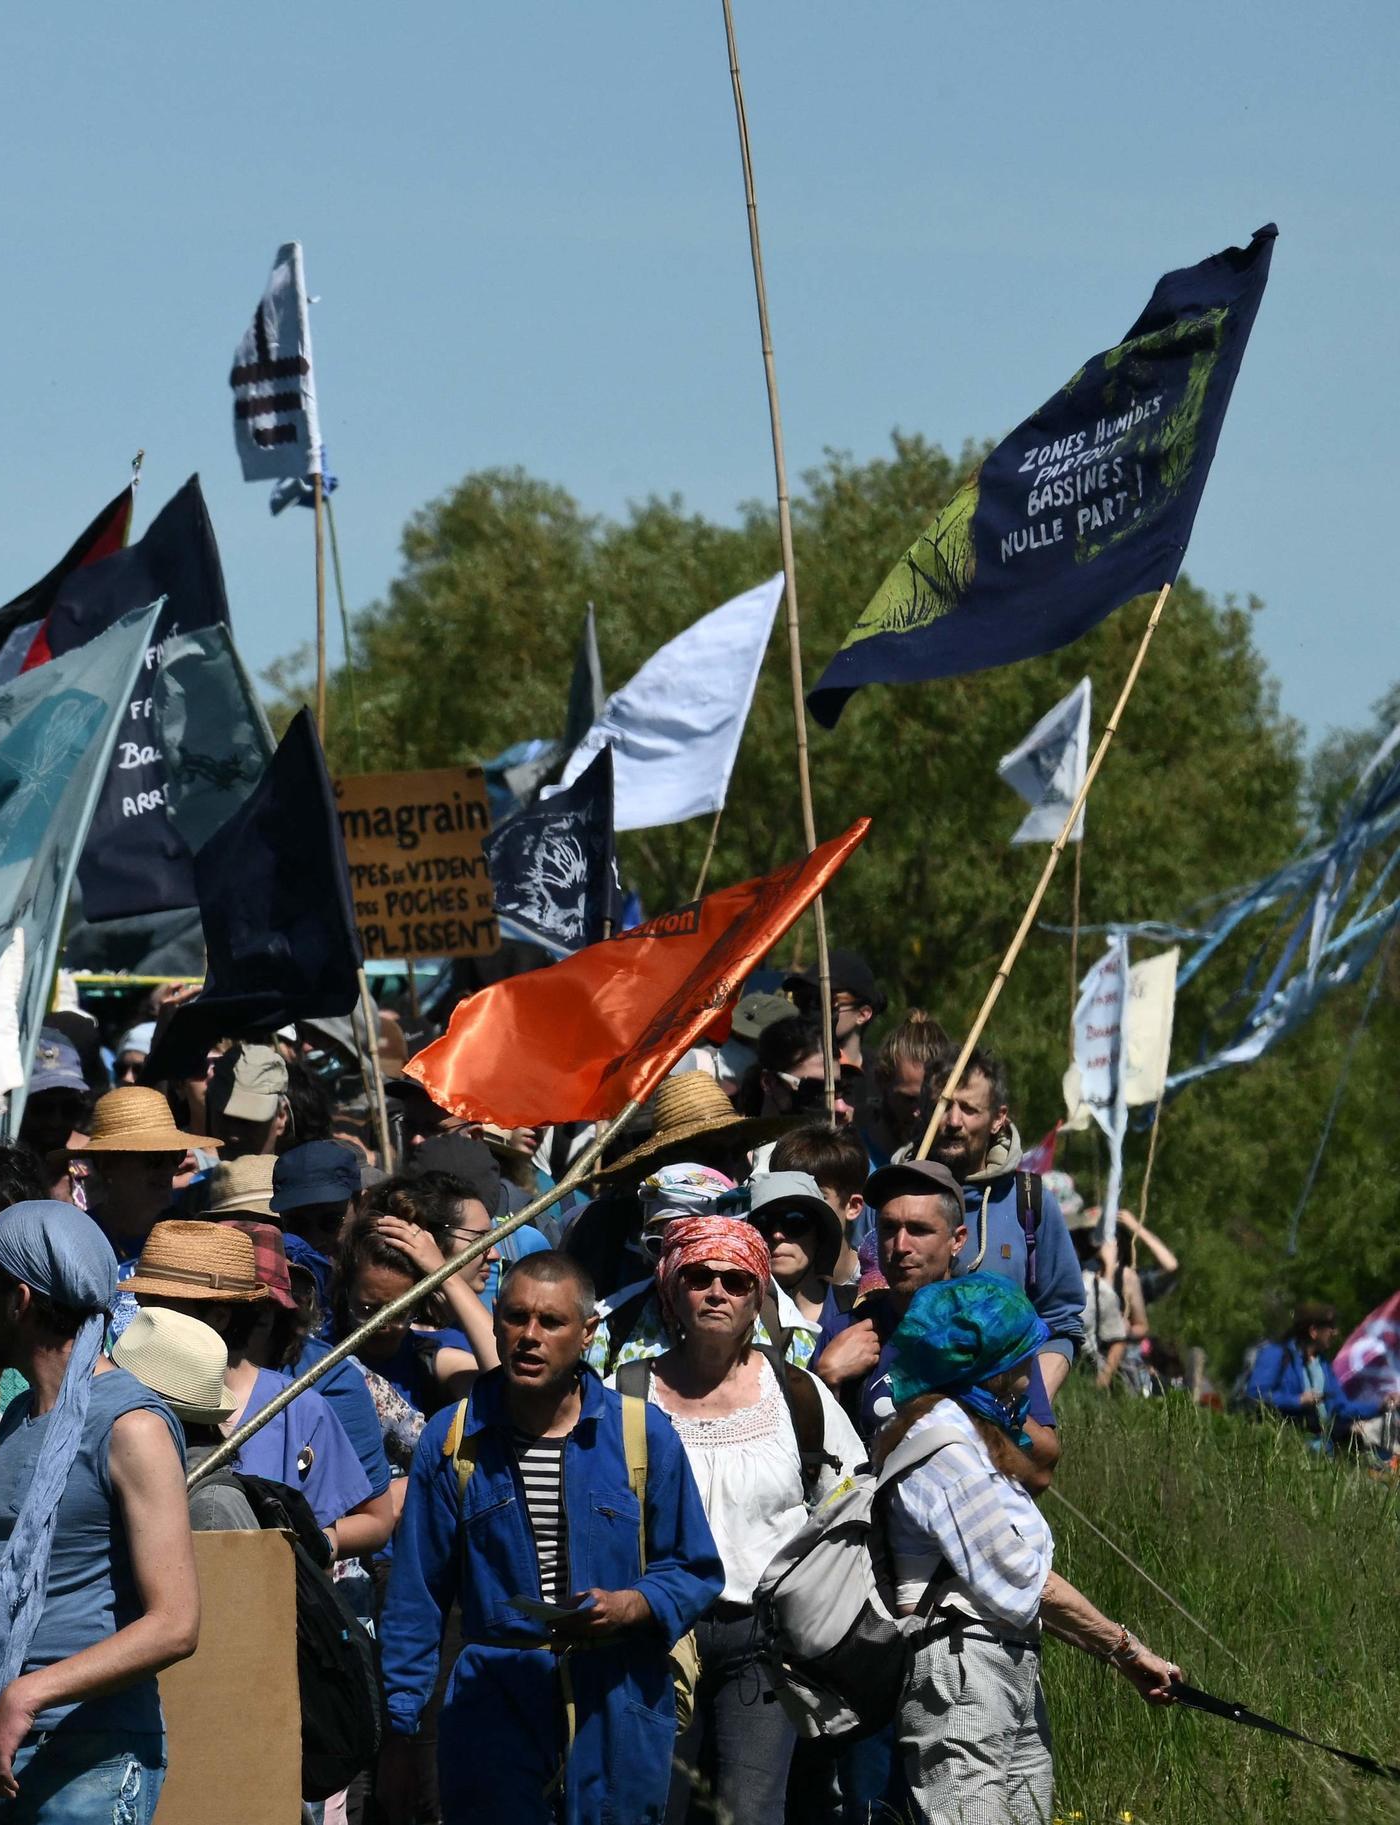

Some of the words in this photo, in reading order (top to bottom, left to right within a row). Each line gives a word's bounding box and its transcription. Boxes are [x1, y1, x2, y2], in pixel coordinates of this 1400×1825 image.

[1018, 431, 1087, 473] ZONES
[1033, 436, 1125, 487] PARTOUT
[1000, 518, 1064, 563] NULLE
[385, 888, 469, 918] POCHES
[359, 917, 497, 957] PLISSENT
